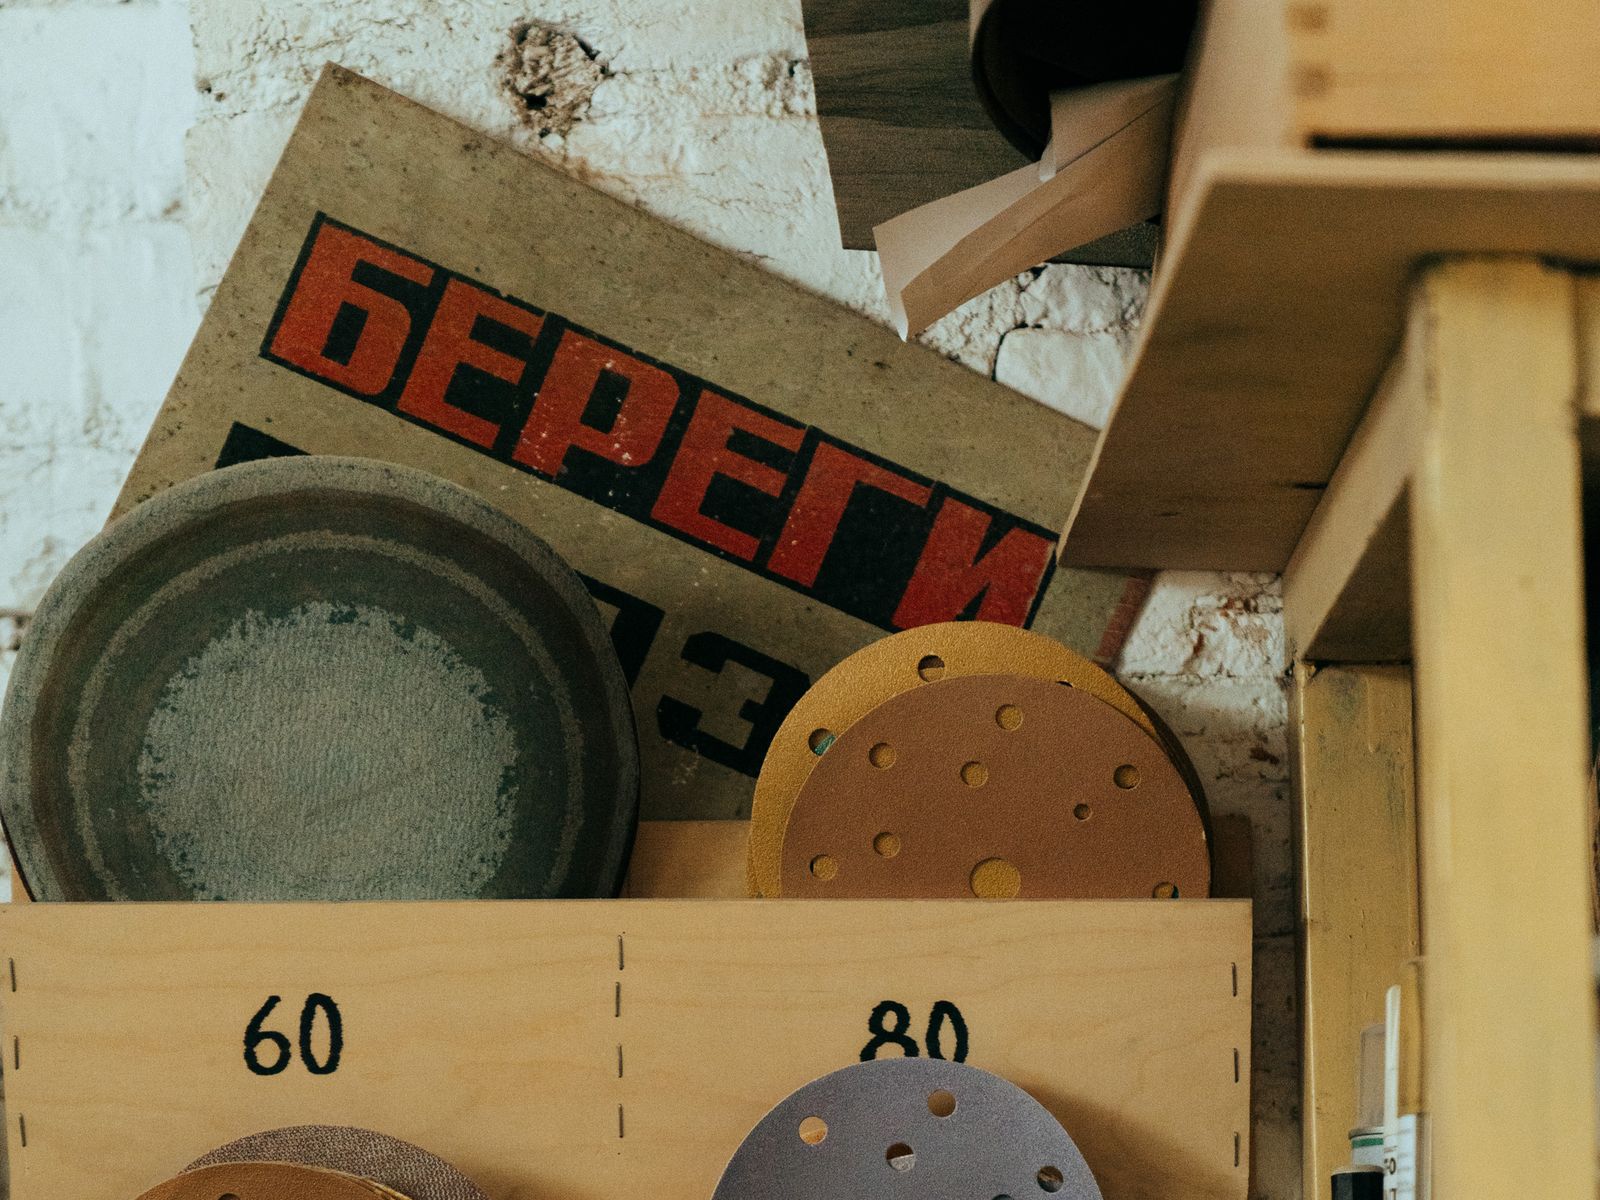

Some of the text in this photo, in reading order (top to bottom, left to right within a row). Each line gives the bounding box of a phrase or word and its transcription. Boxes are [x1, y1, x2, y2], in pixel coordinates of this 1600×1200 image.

[261, 211, 1060, 632] БЕРЕГИ
[243, 992, 344, 1076] 60
[858, 1000, 969, 1064] 80
